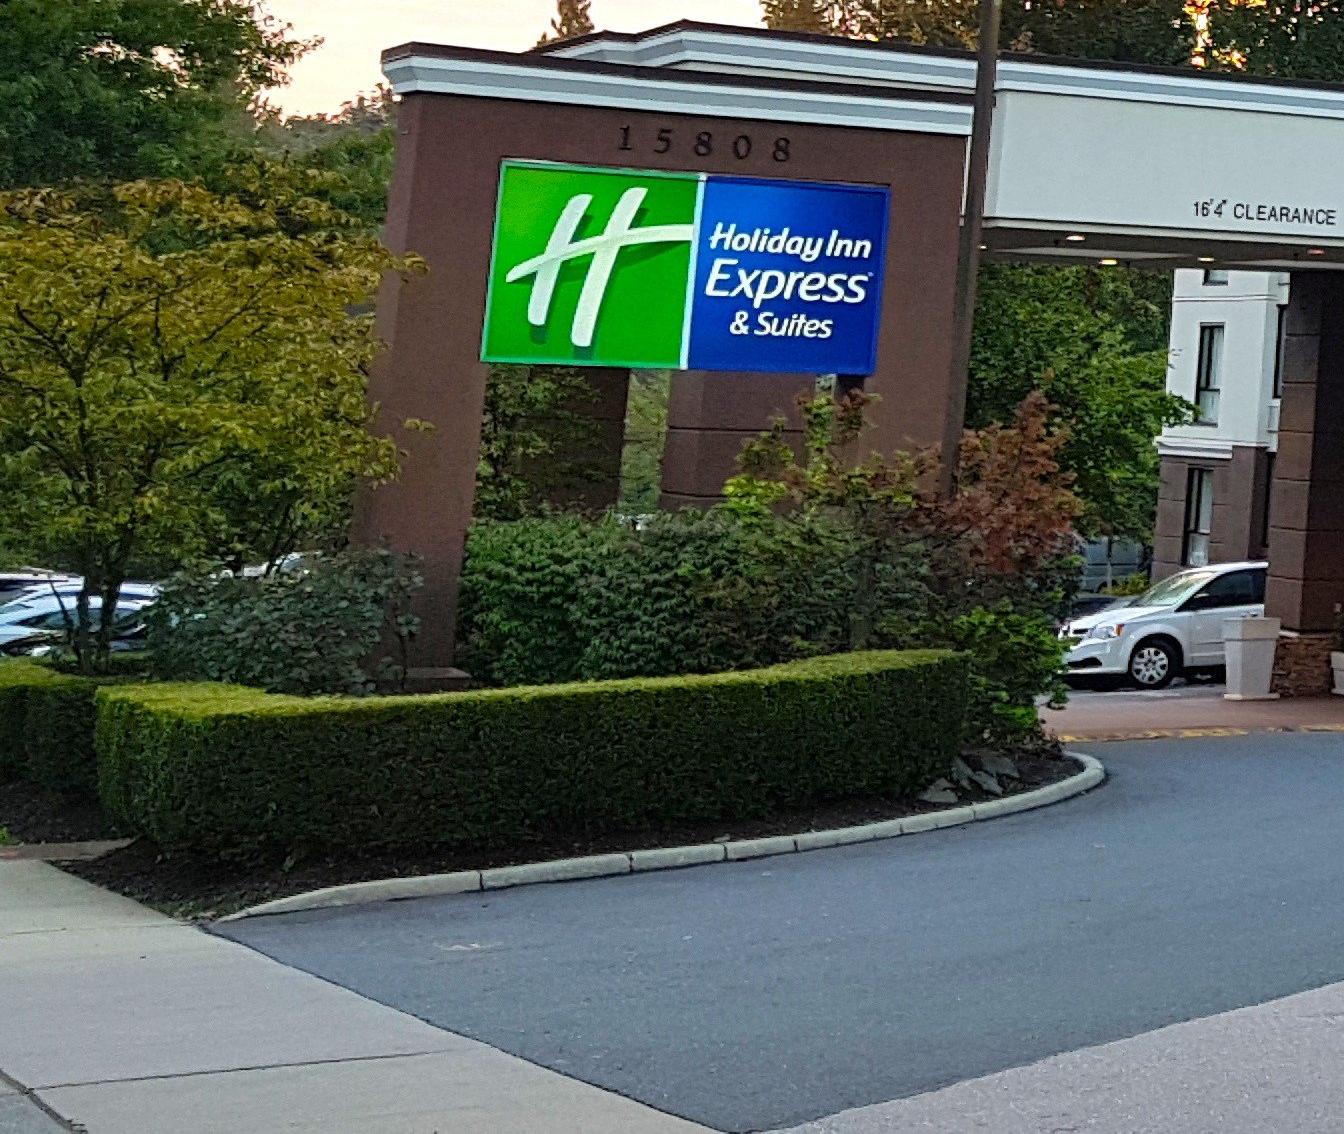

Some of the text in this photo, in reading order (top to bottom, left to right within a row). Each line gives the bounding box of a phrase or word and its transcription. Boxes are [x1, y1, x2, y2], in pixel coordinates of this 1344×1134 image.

[618, 125, 792, 163] 15808
[1233, 203, 1337, 226] CLEARANCE
[708, 222, 872, 262] Holiday Inn
[705, 258, 869, 308] Express
[729, 311, 833, 339] & Suites
